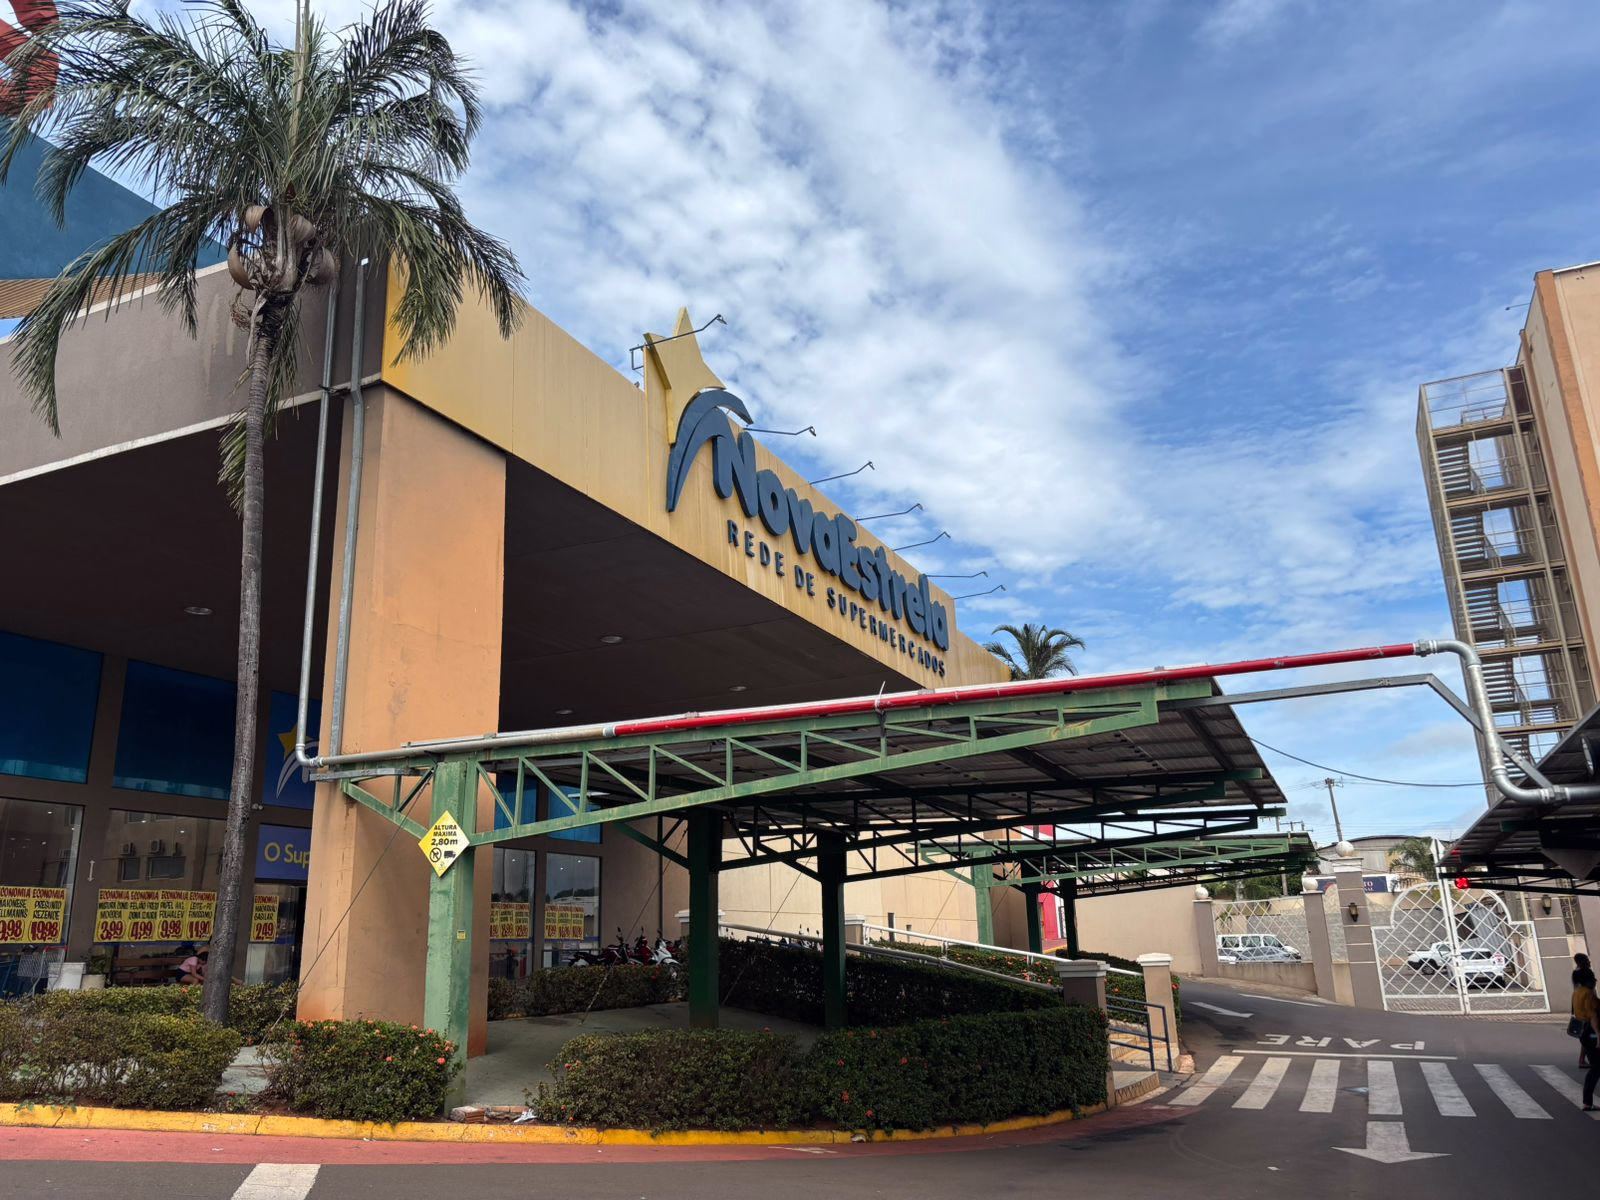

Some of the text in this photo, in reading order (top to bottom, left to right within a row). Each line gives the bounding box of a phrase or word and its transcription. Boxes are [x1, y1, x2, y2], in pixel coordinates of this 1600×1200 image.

[727, 518, 946, 678] REDE DE SUPERMERCADOS
[264, 842, 310, 869] O Sup
[0, 887, 31, 899] CONOMIA
[32, 888, 65, 900] ECONOMIA
[99, 890, 129, 900] ECONOMIA
[130, 890, 159, 900] ECONOMIA
[161, 891, 189, 900] ECONOMIA
[190, 891, 216, 902] ECONOMIA
[255, 895, 279, 905] ECONOMIA
[100, 920, 123, 940] 3,99
[130, 920, 154, 940] 4,99
[160, 920, 182, 939] 9,98
[1256, 1034, 1426, 1051] PARE
